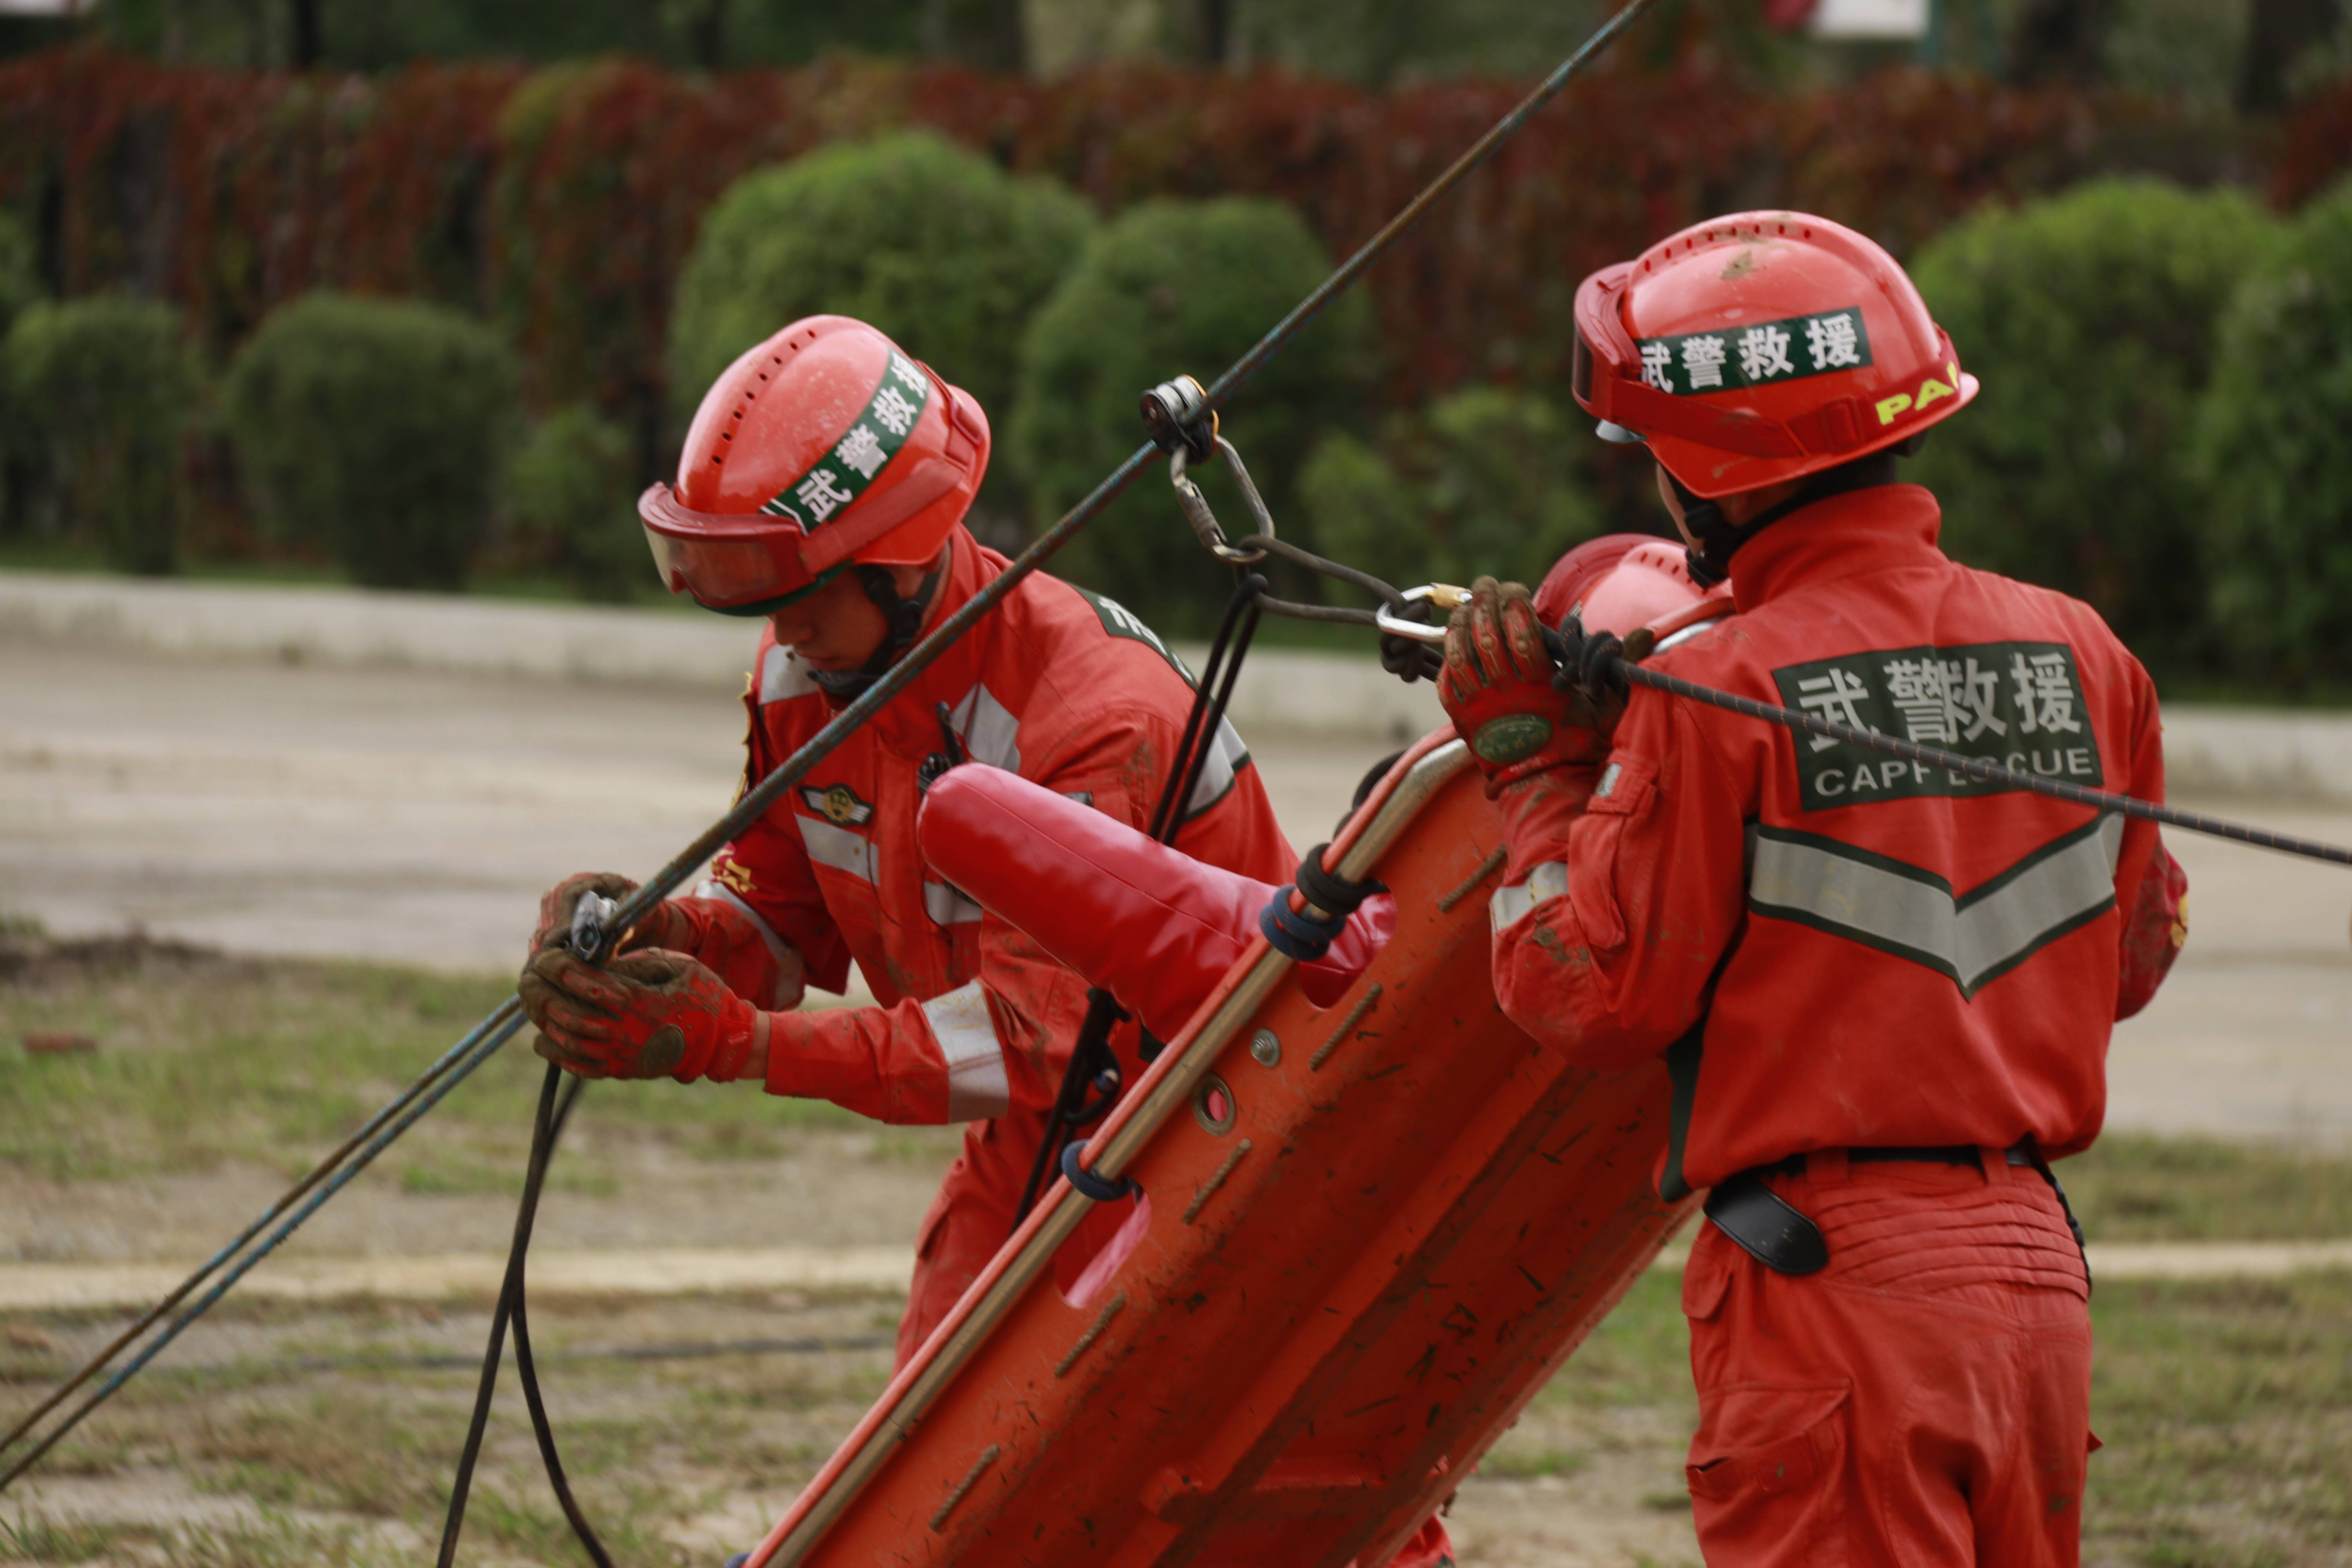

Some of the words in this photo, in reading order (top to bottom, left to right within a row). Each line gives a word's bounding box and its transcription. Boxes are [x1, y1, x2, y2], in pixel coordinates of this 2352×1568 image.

[1641, 314, 1860, 394] 武警救援
[1798, 652, 2081, 753] 武警救援
